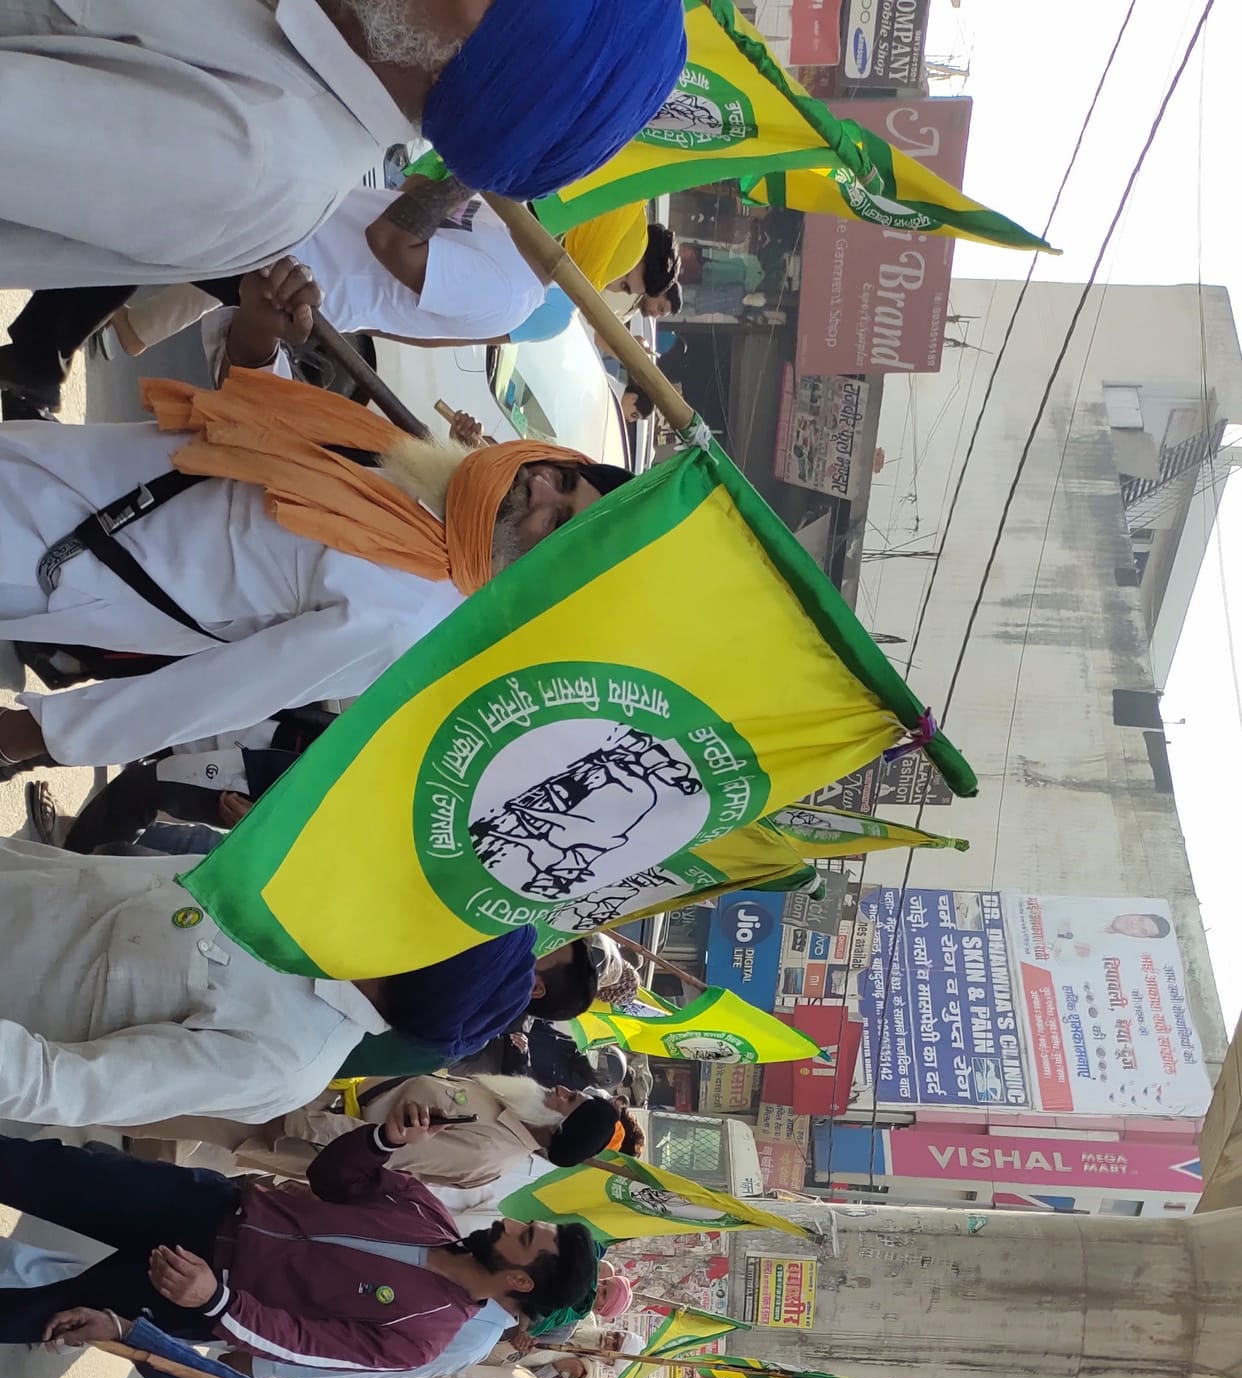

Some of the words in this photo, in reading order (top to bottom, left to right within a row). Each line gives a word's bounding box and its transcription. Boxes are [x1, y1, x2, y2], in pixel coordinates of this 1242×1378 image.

[874, 40, 889, 76] Shop
[870, 251, 926, 370] Brand
[825, 311, 841, 348] Shop
[476, 677, 540, 734] यूनियन
[537, 677, 602, 712] किसान
[607, 678, 672, 720] भारतीय
[431, 716, 493, 788] (एकता)
[843, 773, 862, 810] New
[735, 909, 761, 943] Jio
[937, 894, 956, 930] चर्म
[981, 894, 1000, 924] DR.
[732, 949, 742, 969] LIFE
[742, 949, 755, 984] DIGITAL
[940, 934, 958, 973] रोग
[961, 936, 986, 982] SKIN
[915, 969, 929, 980] व
[945, 978, 959, 995] व
[986, 928, 1014, 1030] DHAMIJA'S
[892, 996, 905, 1006] के
[967, 987, 986, 1001] &
[893, 1008, 907, 1035] सामने
[942, 1000, 965, 1050] गुप्त
[969, 1006, 995, 1053] PAIN
[922, 1046, 939, 1068] का
[1000, 1034, 1025, 1104] CLINIC
[925, 1072, 947, 1096] दर्द
[951, 1055, 972, 1099] रोग
[927, 1145, 1073, 1173] VISHAL
[1080, 1153, 1128, 1164] MEGA
[1083, 1162, 1126, 1175] MART
